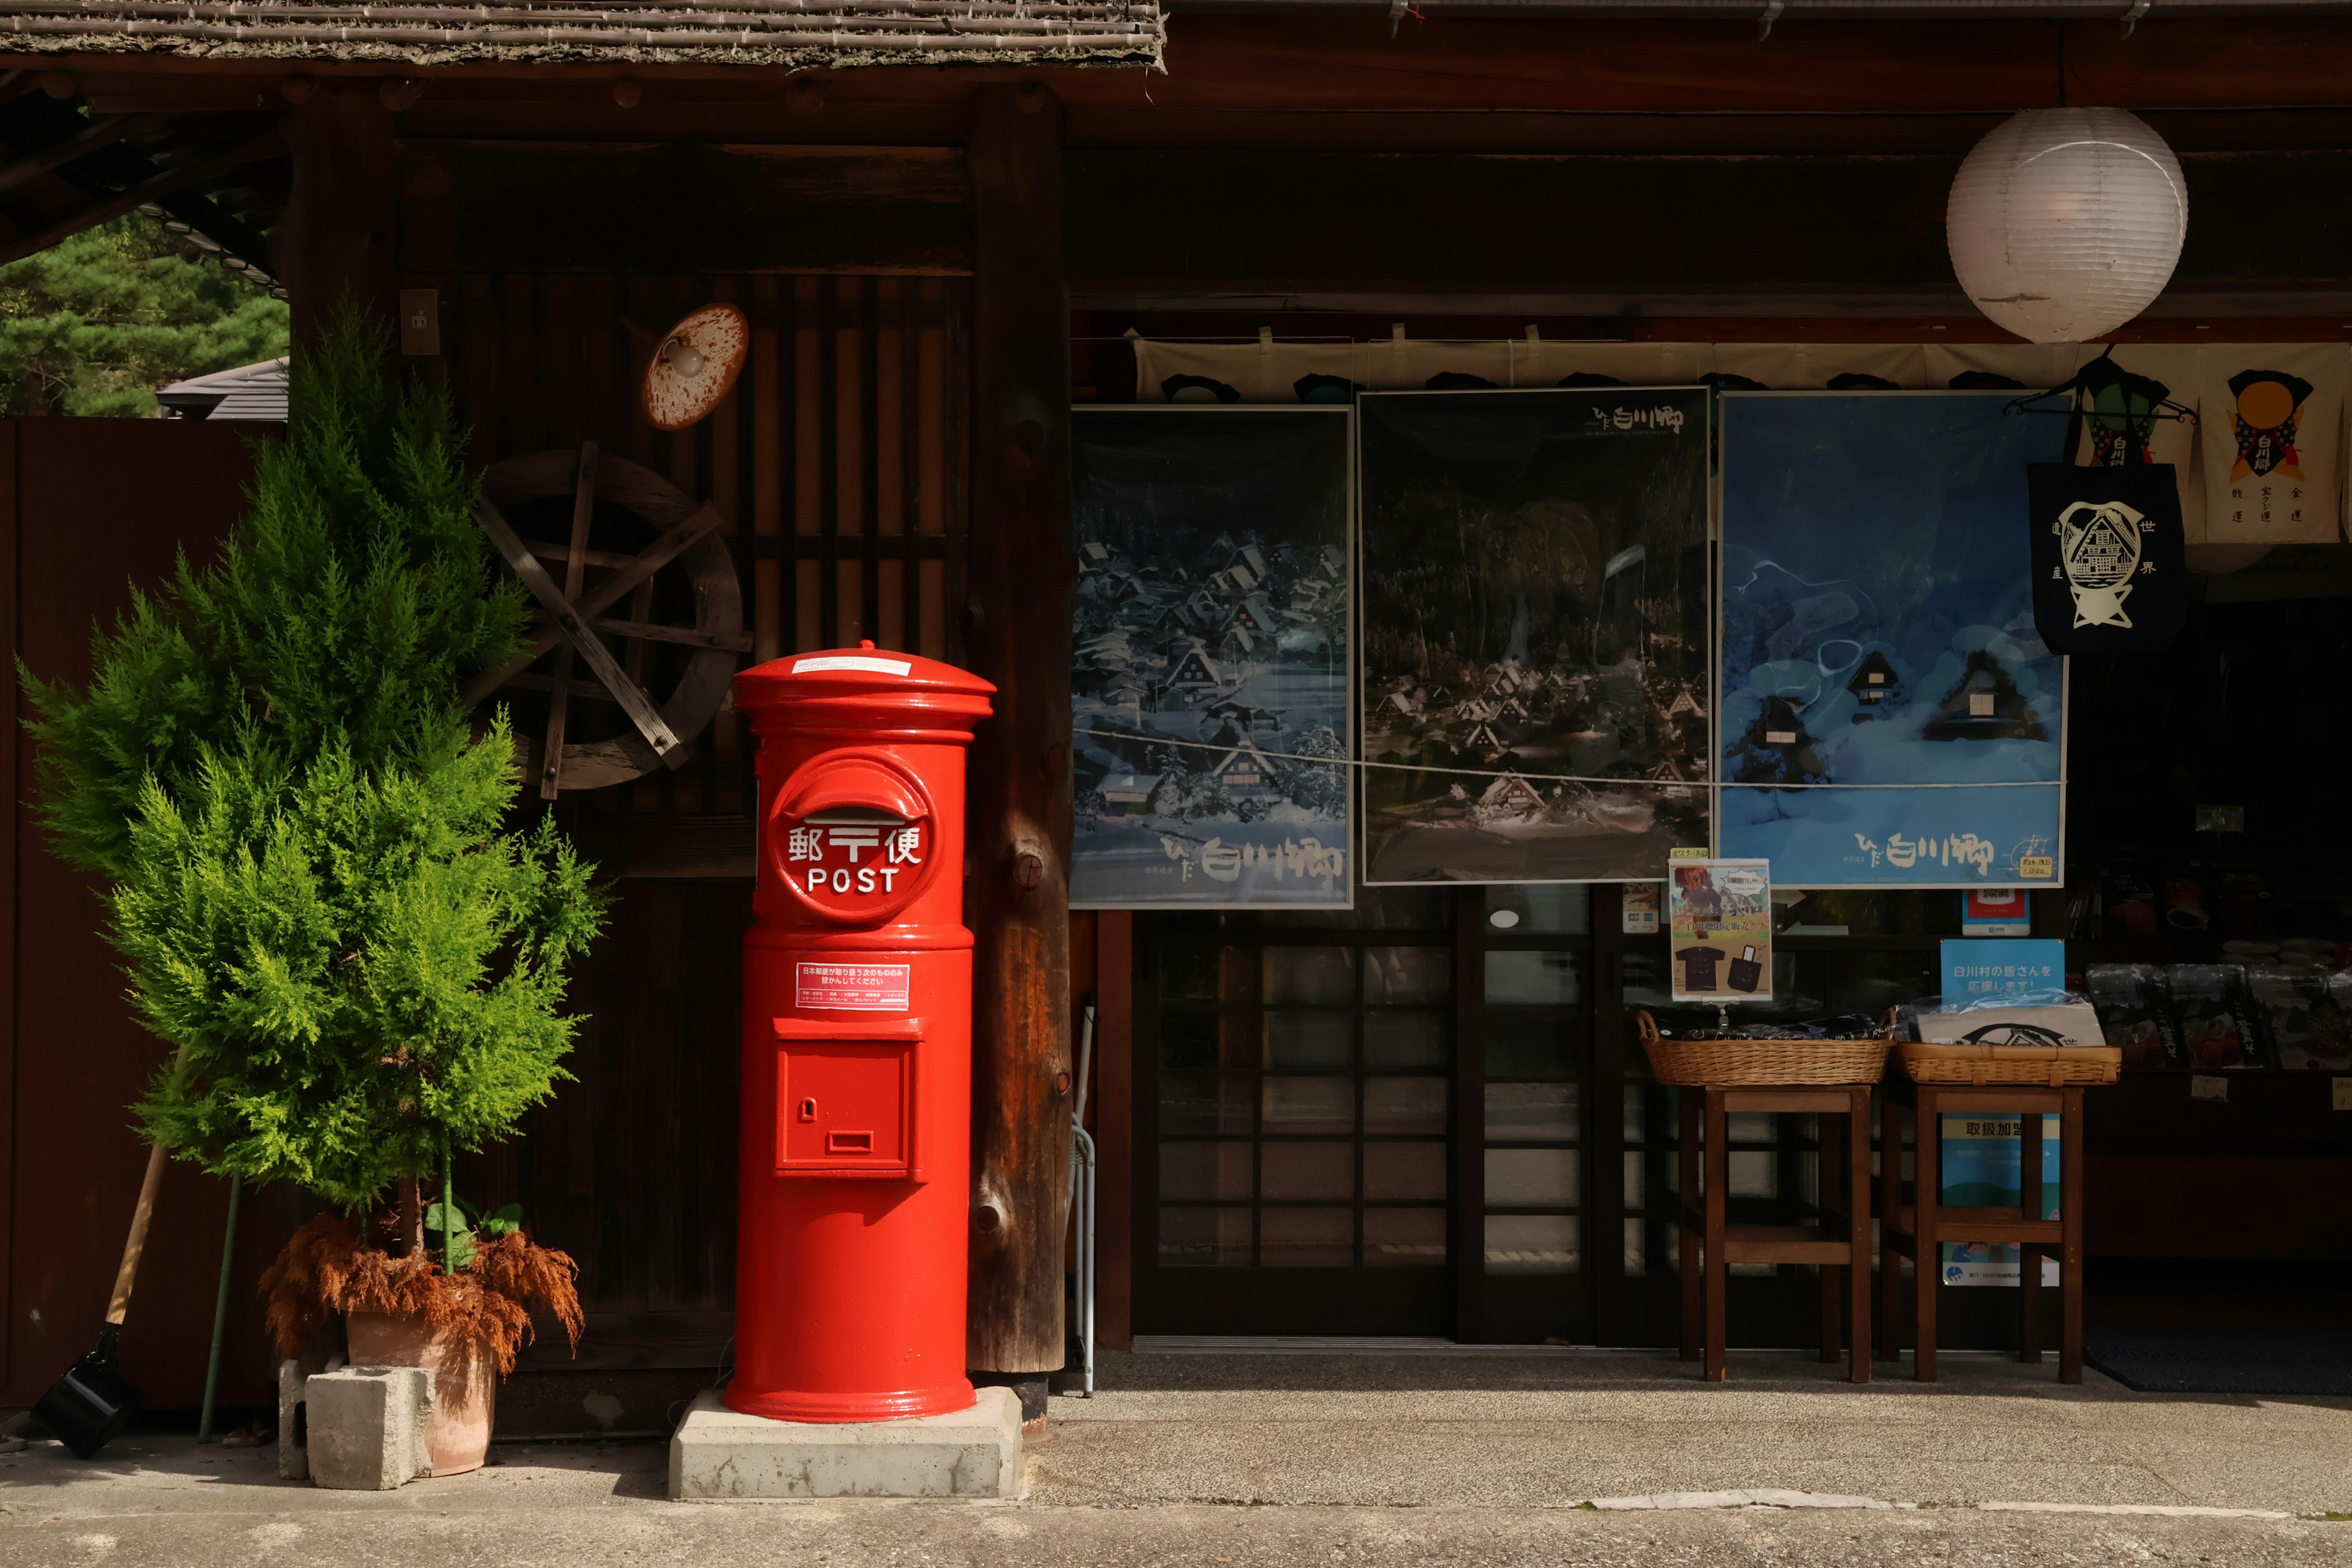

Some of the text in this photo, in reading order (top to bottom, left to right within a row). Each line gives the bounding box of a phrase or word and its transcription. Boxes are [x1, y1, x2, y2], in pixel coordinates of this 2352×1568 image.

[2254, 435, 2271, 471] 白川郷
[808, 867, 900, 894] POST
[803, 967, 903, 976] 日本郵便が取り扱う次のもののみ
[1954, 965, 2052, 978] 白川村の皆さんを
[821, 976, 884, 985] 投かんしてください
